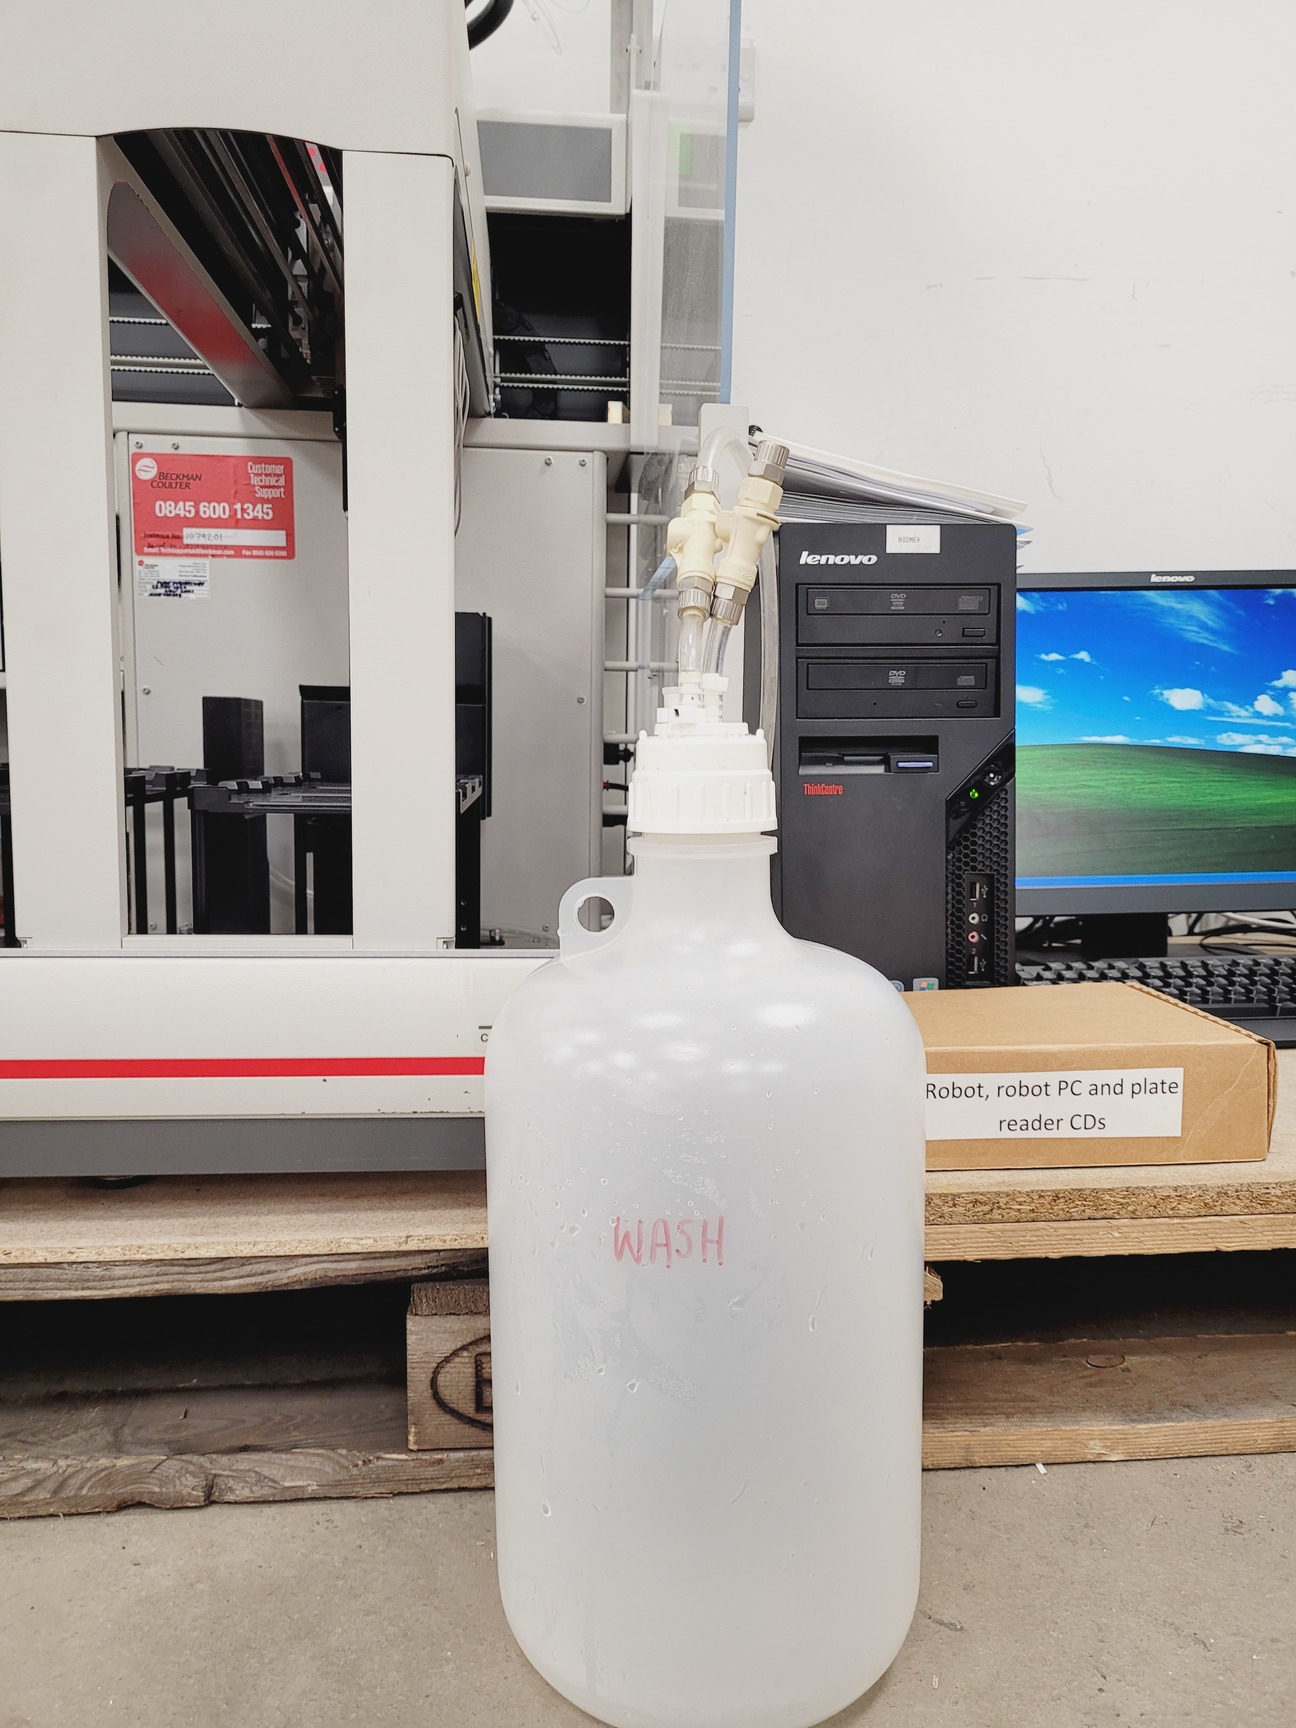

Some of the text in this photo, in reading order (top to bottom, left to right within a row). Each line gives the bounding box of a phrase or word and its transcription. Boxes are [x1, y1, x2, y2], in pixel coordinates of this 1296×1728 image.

[247, 461, 284, 474] Customer
[158, 472, 202, 481] BECKMAN
[250, 473, 285, 486] Technical
[151, 480, 191, 490] COULTER
[255, 486, 285, 499] Support
[155, 500, 273, 520] 0845 600 1345
[897, 536, 922, 544] BIOMEK
[799, 550, 878, 565] lenovo
[1150, 573, 1195, 583] lenovo
[803, 783, 843, 795] ThinkCentre
[926, 1077, 1179, 1101] Robot, robot PC and plate
[999, 1113, 1106, 1132] reader CDs
[613, 1214, 724, 1269] WASH
